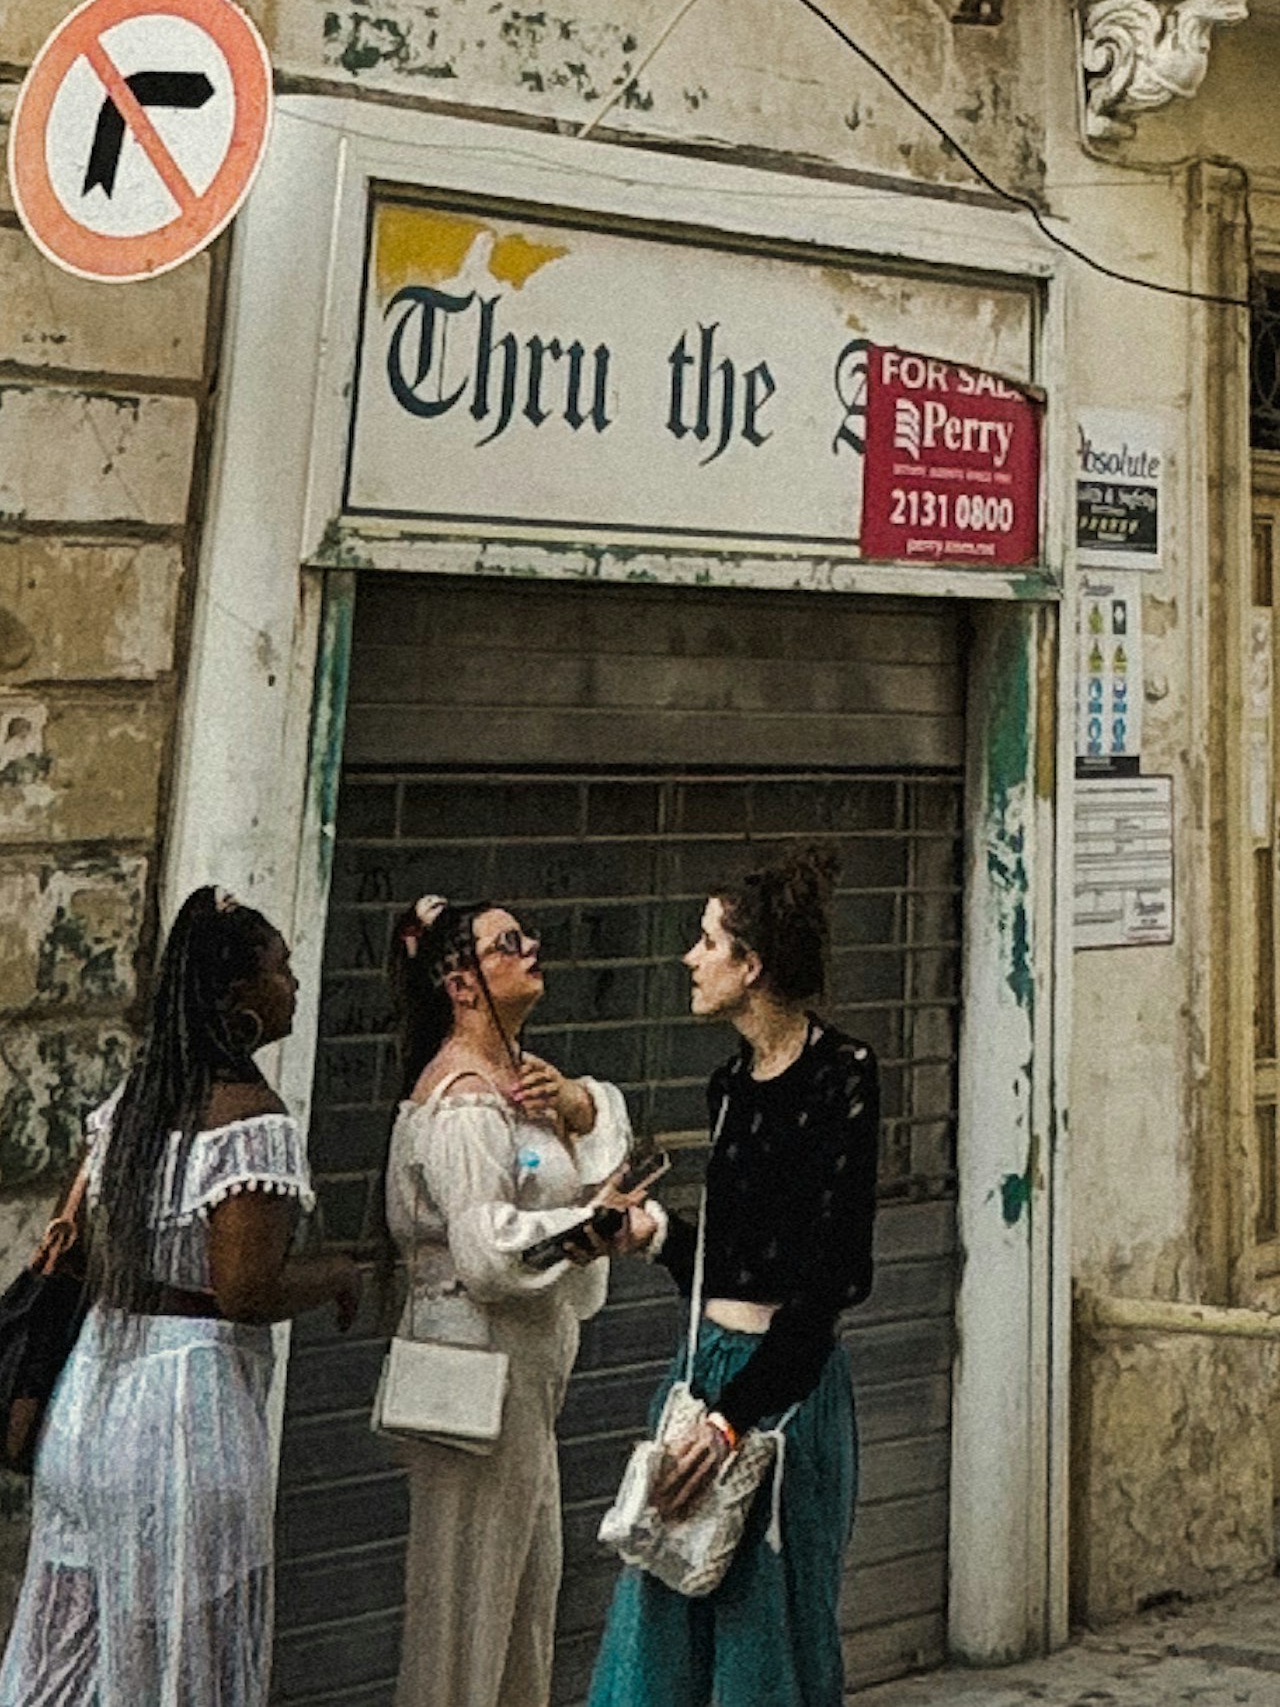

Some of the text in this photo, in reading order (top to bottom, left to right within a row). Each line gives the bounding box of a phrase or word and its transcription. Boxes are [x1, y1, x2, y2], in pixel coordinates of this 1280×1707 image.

[382, 285, 612, 449] Thru
[665, 321, 777, 467] the
[881, 351, 1025, 403] FOR SAL
[922, 400, 1013, 468] Perry
[889, 488, 1014, 533] 2131 0800
